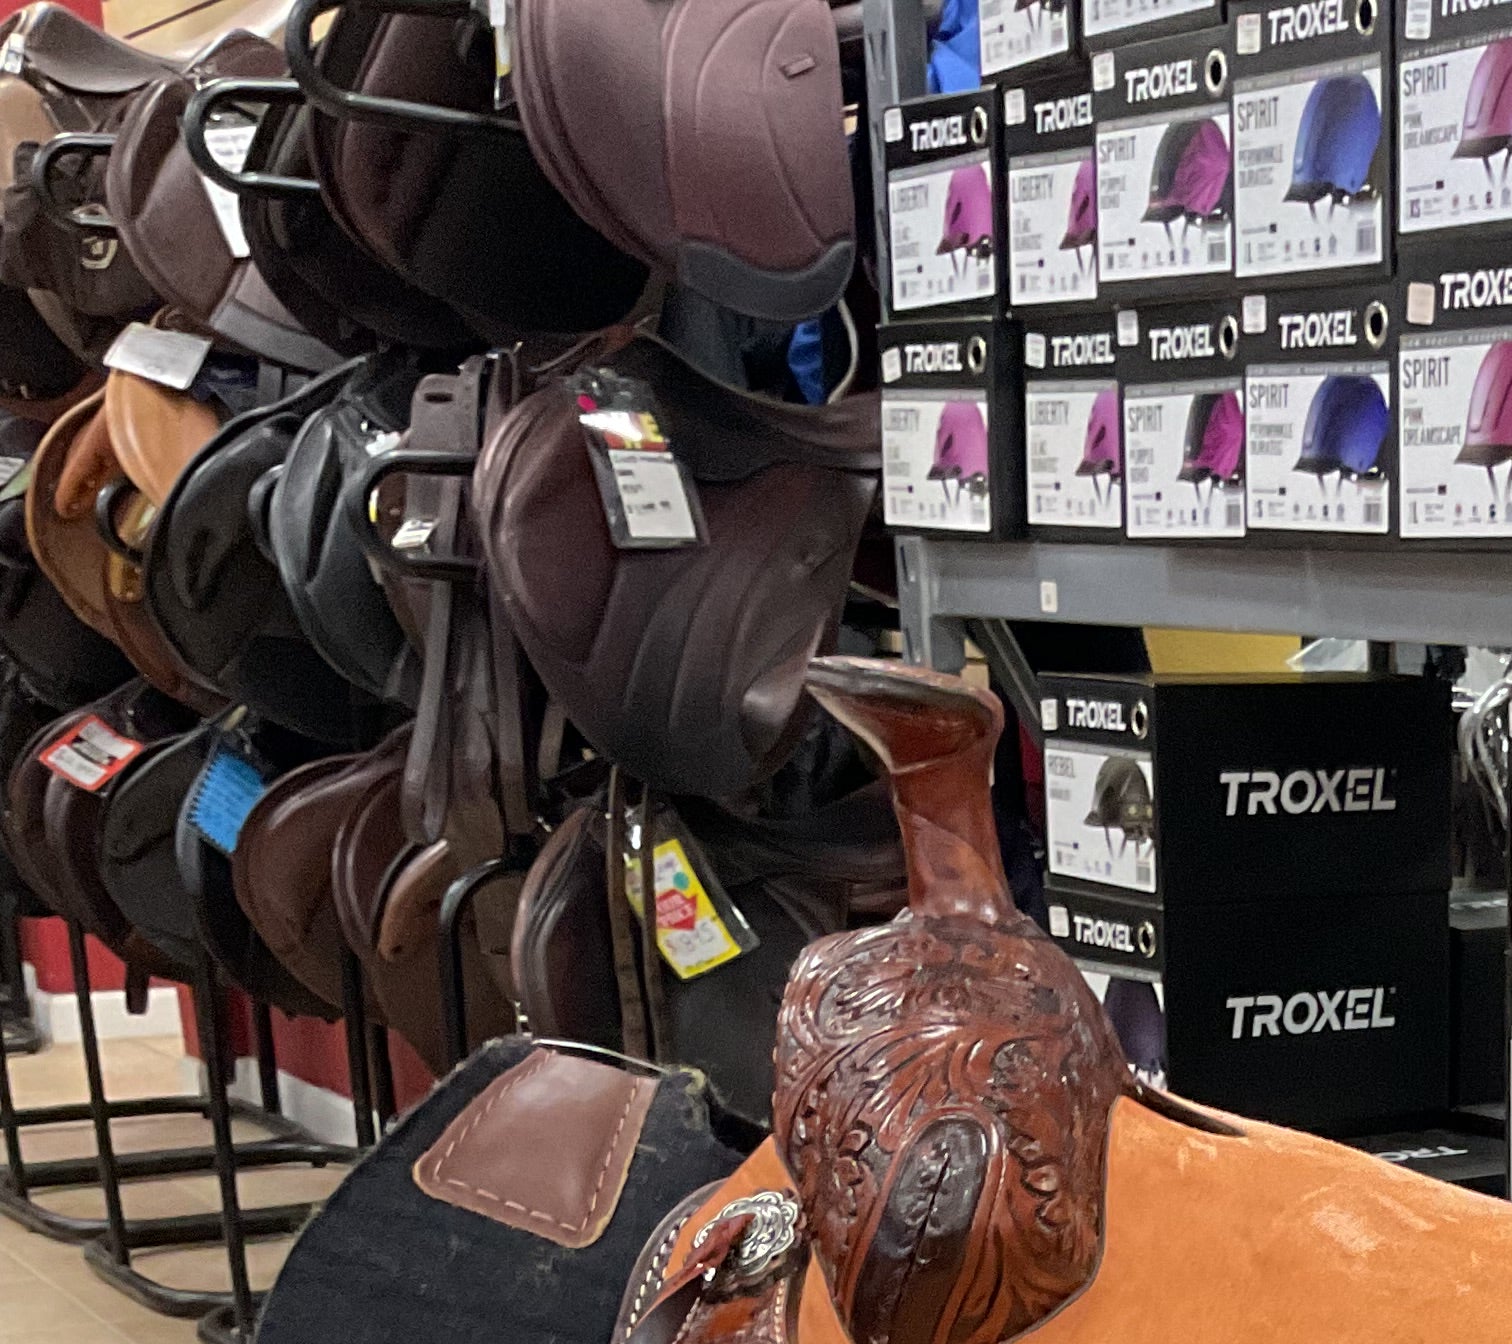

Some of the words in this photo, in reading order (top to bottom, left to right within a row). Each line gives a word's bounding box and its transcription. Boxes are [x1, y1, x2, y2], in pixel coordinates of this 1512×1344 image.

[1267, 1, 1349, 45] TROXEL
[1124, 59, 1198, 104] TROXEL
[1403, 63, 1448, 97] SPIRIT
[1033, 94, 1093, 133] TROXEL
[1237, 96, 1279, 132] SPIRIT
[909, 115, 967, 151] TROXEL
[1099, 136, 1136, 162] SPIRIT
[1149, 324, 1214, 360] TROXEL
[1278, 311, 1357, 349] TROXEL
[904, 342, 962, 373] TROXEL
[1051, 333, 1115, 367] TROXEL
[1403, 357, 1450, 388] SPIRIT
[1249, 383, 1289, 409] SPIRIT
[1128, 405, 1163, 432] SPIRIT
[1066, 699, 1127, 732] TROXEL
[1219, 768, 1397, 816] TROXEL
[1073, 914, 1134, 953] TROXEL
[1225, 987, 1395, 1039] TROXEL
